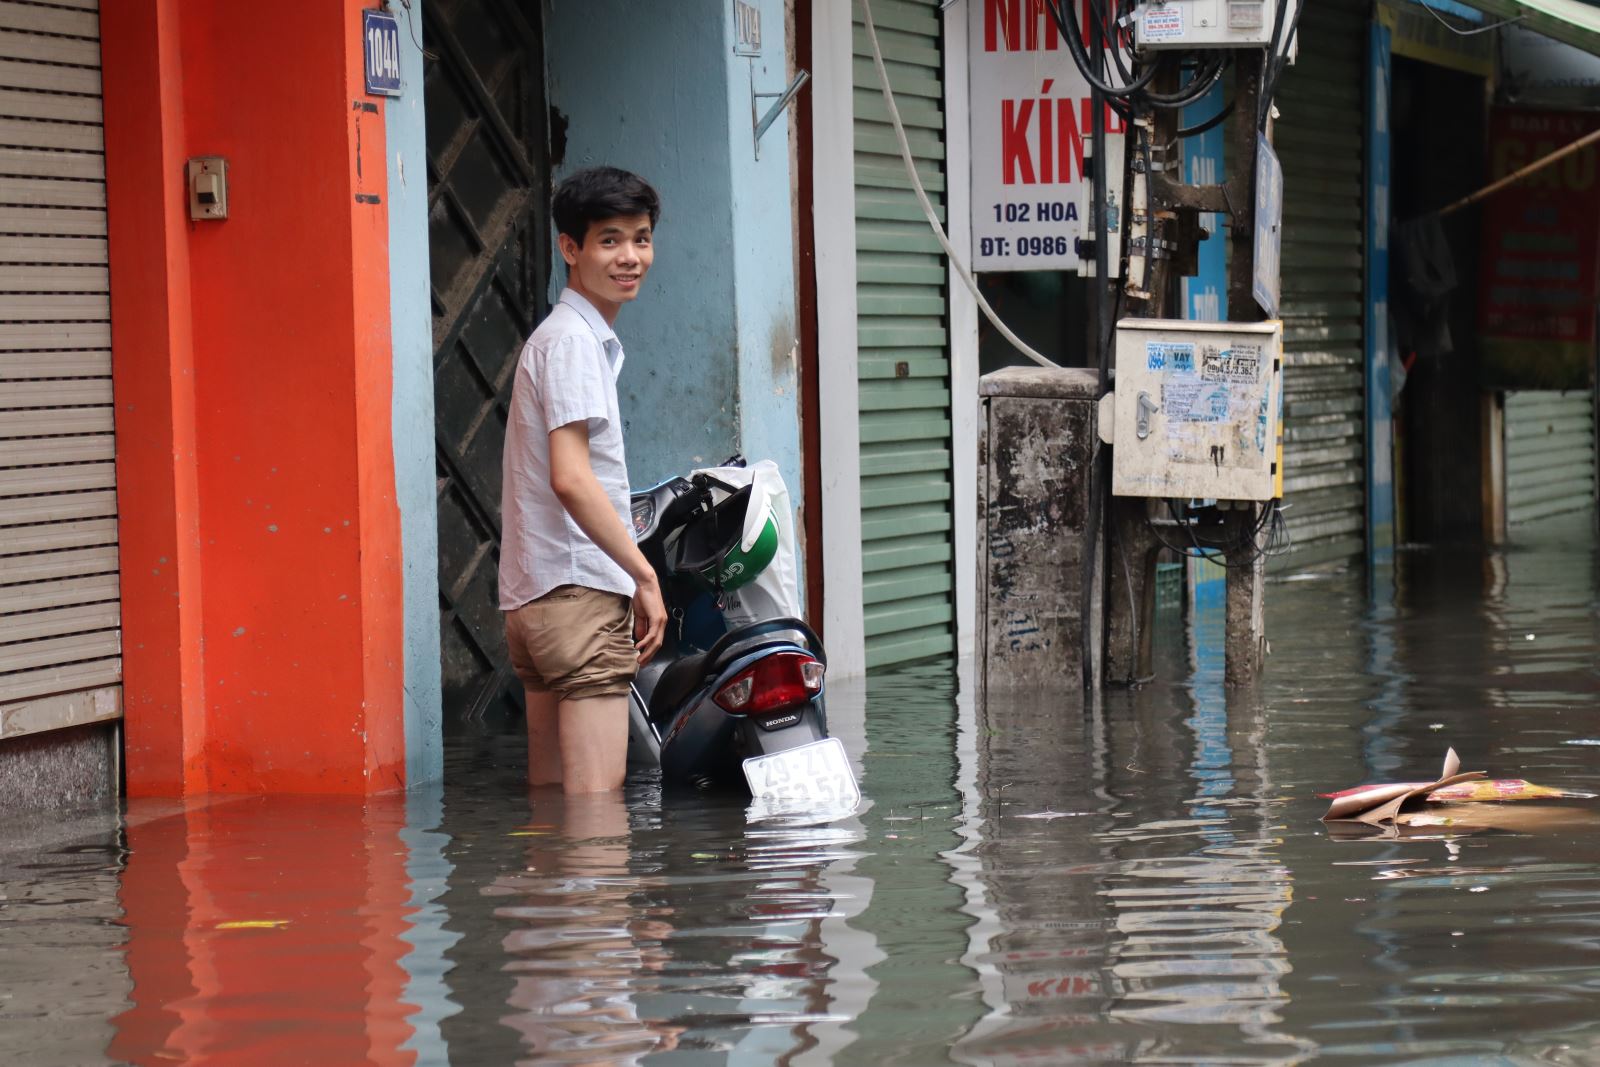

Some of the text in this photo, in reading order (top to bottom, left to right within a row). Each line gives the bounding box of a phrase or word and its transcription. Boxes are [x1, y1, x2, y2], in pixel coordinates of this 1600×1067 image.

[737, 3, 761, 45] 104
[368, 27, 400, 79] 104A
[993, 202, 1078, 222] 102 HOA
[981, 237, 1010, 257] ĐT:
[1017, 236, 1067, 256] 0986
[1173, 352, 1190, 362] VAY
[765, 715, 798, 728] HONDA
